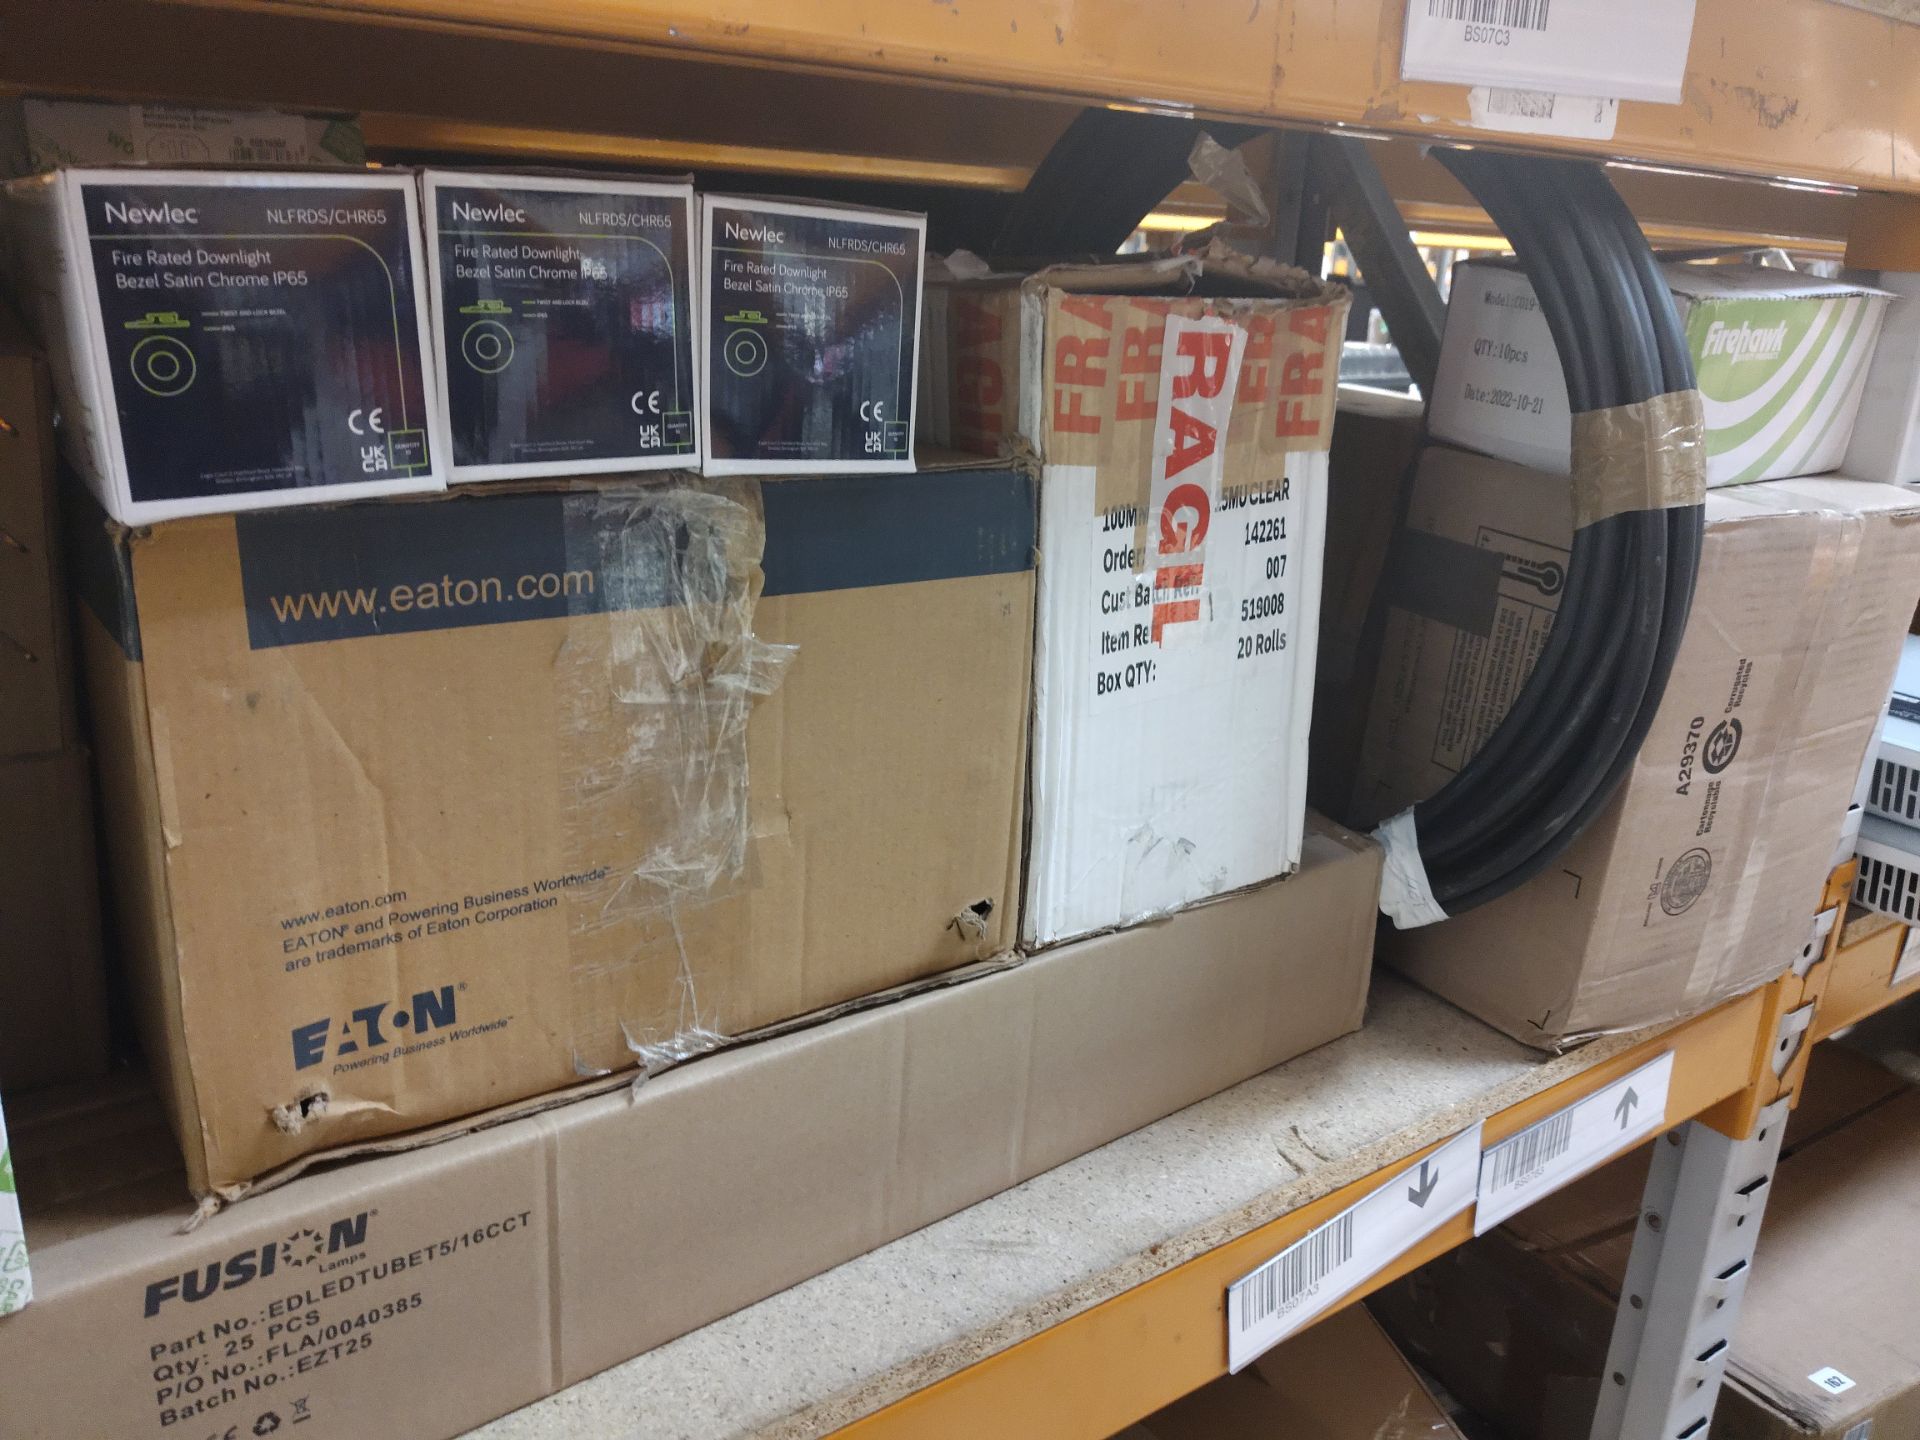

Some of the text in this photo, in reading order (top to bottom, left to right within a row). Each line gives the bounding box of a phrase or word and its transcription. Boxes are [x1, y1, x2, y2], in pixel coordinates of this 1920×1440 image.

[1464, 25, 1510, 46] BS07C3
[105, 202, 199, 225] Newlec
[267, 208, 387, 226] NLFRDS/CHR65
[452, 201, 526, 223] Newlec
[579, 212, 672, 229] NLFRDS/CHR65
[725, 221, 784, 244] Newlec
[828, 236, 906, 256] NLFRDS/CHR65
[111, 249, 271, 269] Fire Rated Downlight
[455, 244, 581, 261] Fire Rated Downlight
[116, 270, 308, 289] Bezel Satin Chrome IP65
[456, 265, 490, 279] Bezel
[494, 265, 525, 280] Satin
[529, 265, 577, 280] Chrome
[724, 260, 827, 281] Fire Rated Downlight
[724, 278, 848, 300] Bezel Satin Chrome IP65
[1702, 320, 1788, 366] Firehawk
[1249, 477, 1290, 506] CLEAR
[1245, 516, 1287, 546] 142261
[1265, 555, 1287, 580] 007
[271, 570, 595, 622] www.eaton.com
[1101, 629, 1129, 656] Item
[1241, 592, 1285, 621] 519008
[1097, 628, 1286, 696] Box QTY: 20 Rolls
[1724, 658, 1747, 714] Corrugated
[1733, 661, 1753, 708] Recycles
[1676, 715, 1706, 797] A29370
[280, 889, 407, 931] www.eaton.com
[354, 917, 384, 935] and
[389, 902, 459, 927] Powering
[463, 885, 529, 910] Business
[285, 896, 558, 973] are trademarks of Eaton Corporation
[333, 1051, 390, 1076] Powering
[393, 1036, 446, 1059] Business
[319, 1251, 367, 1273] Lamps
[150, 1330, 206, 1362] Part
[153, 1310, 321, 1383] Qty: 25 PCS
[156, 1376, 204, 1405] P/O
[160, 1385, 237, 1428] Batch
